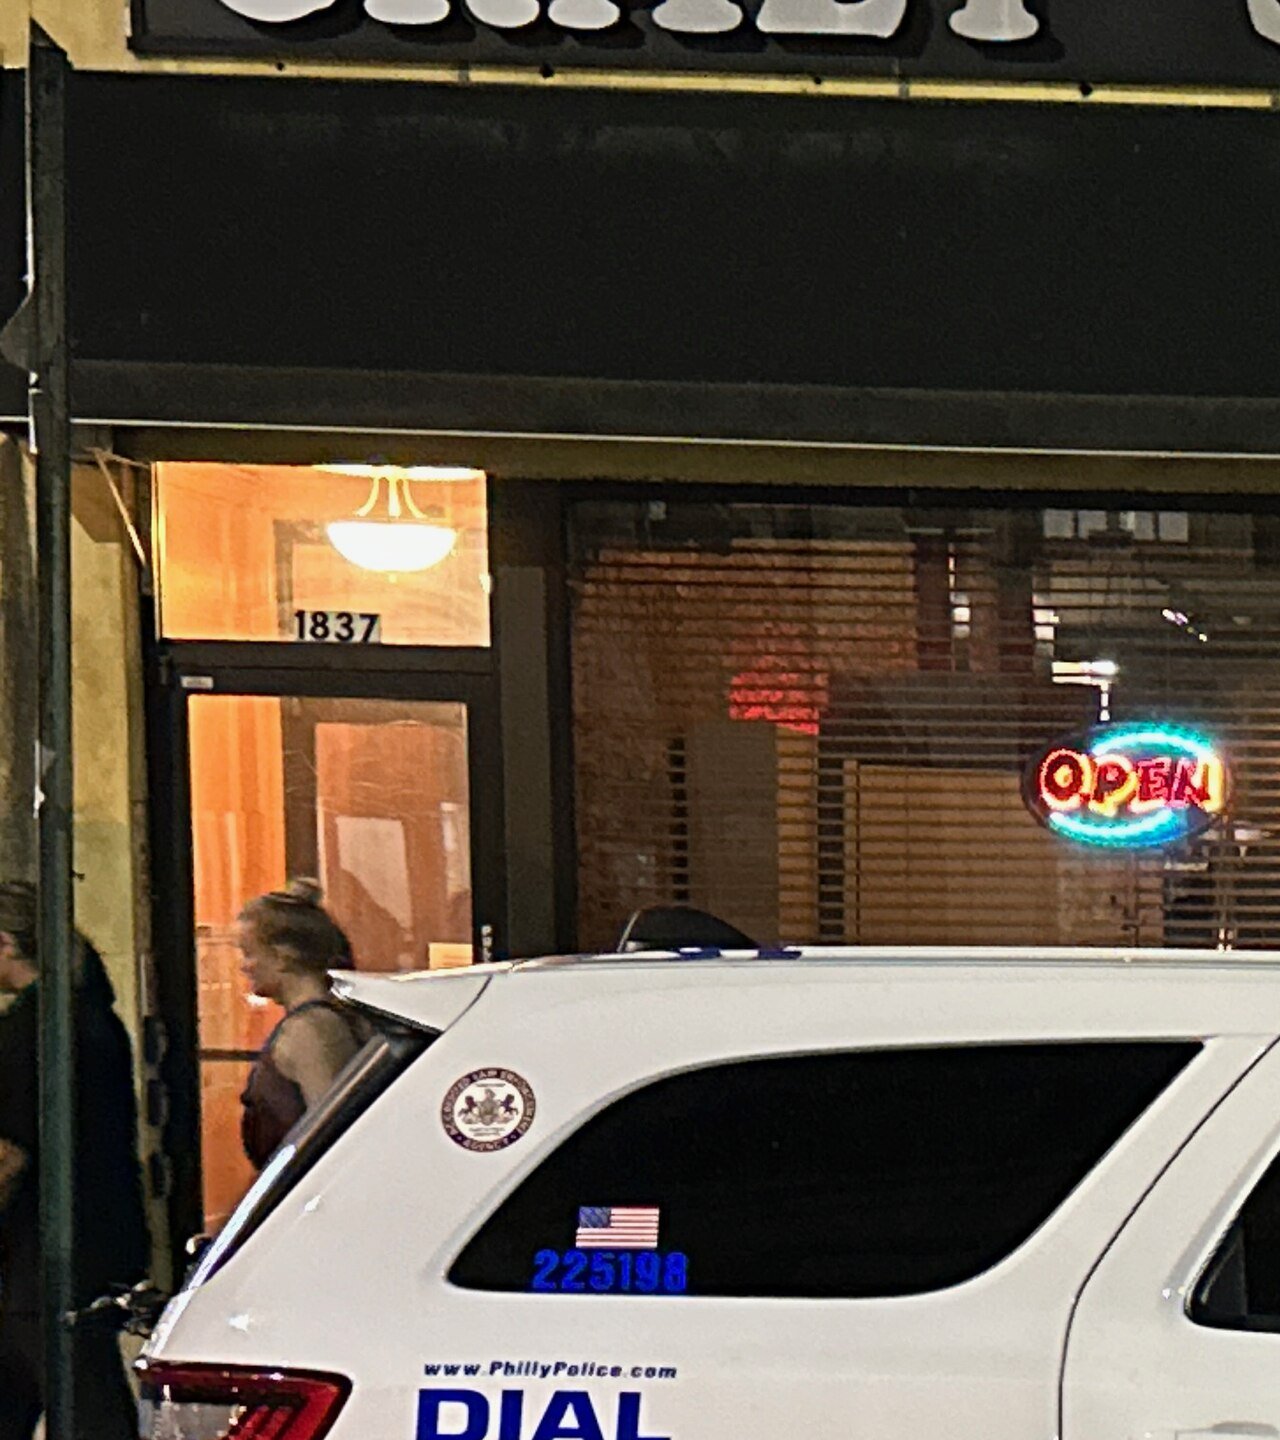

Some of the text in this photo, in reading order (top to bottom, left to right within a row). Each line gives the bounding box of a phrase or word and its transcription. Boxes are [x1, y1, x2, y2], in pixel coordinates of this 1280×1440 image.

[294, 609, 380, 643] 1837
[1040, 748, 1224, 817] OPEN
[532, 1249, 690, 1292] 225198
[424, 1361, 678, 1379] www.PhillyPolice.com
